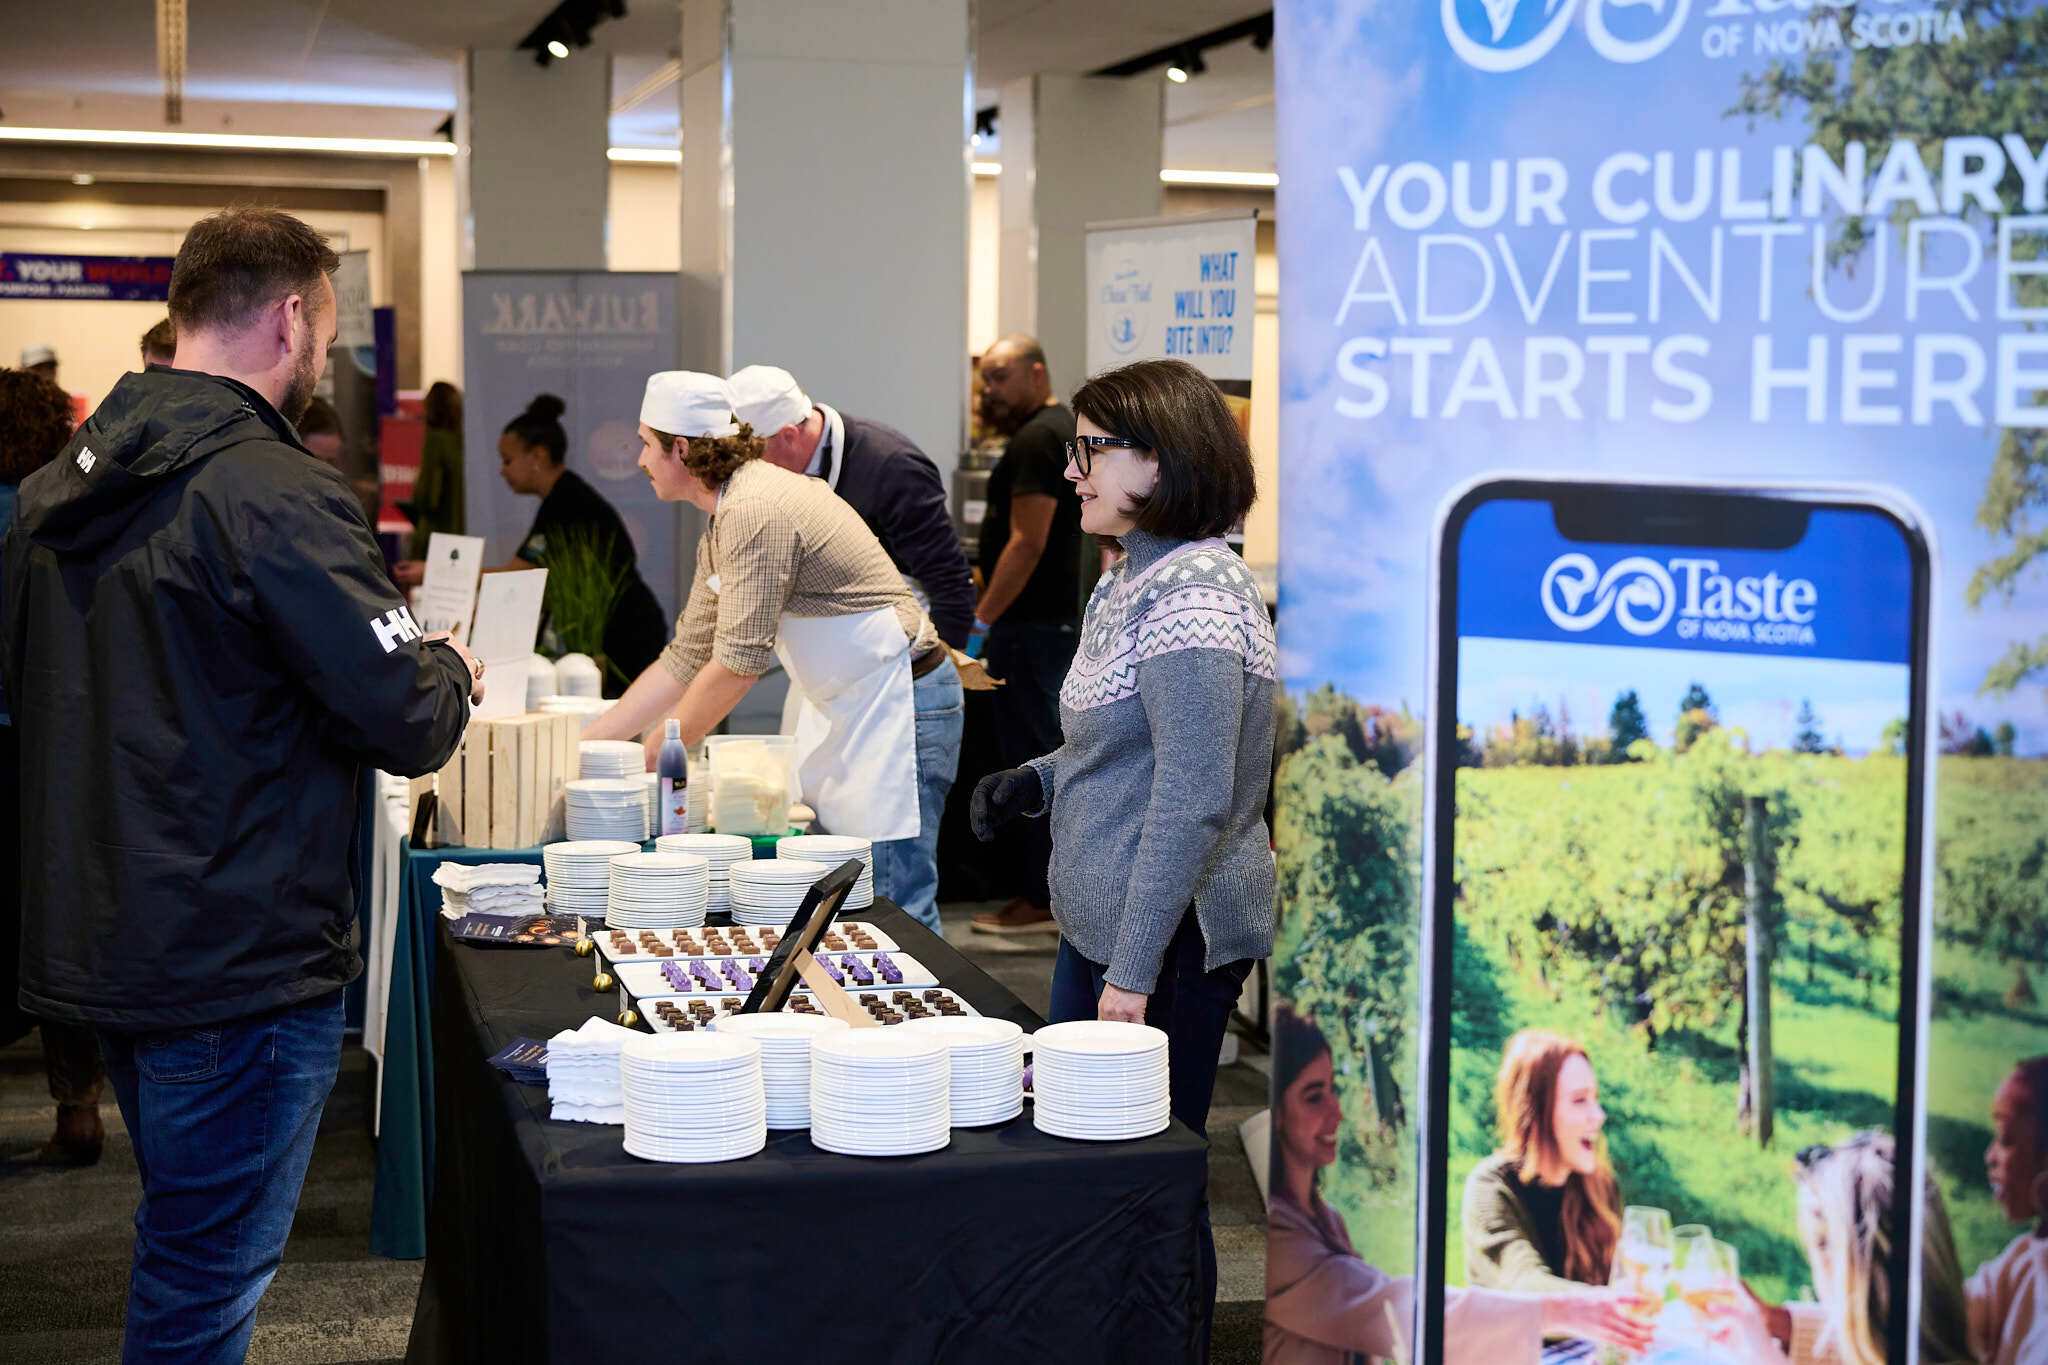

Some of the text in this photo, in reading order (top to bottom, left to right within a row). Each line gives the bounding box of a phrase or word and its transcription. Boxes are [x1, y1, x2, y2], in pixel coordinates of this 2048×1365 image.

[1701, 24, 1743, 58] OF
[1754, 16, 1847, 56] NOVA
[1850, 8, 1969, 50] SCOTIA
[1337, 133, 2048, 231] YOUR CULINARY
[16, 259, 83, 282] YOUR
[1200, 252, 1239, 283] WHAT
[1333, 214, 2048, 327] ADVENTURE
[1174, 289, 1205, 319] WILL
[1210, 289, 1236, 319] YOU
[1165, 324, 1235, 356] BITE INTO?
[1333, 333, 2048, 429] STARTS HERE
[76, 446, 97, 474] HH
[1668, 557, 1818, 624] Taste
[370, 605, 423, 654] HH
[1676, 618, 1817, 647] OF NOVA SCOTIA
